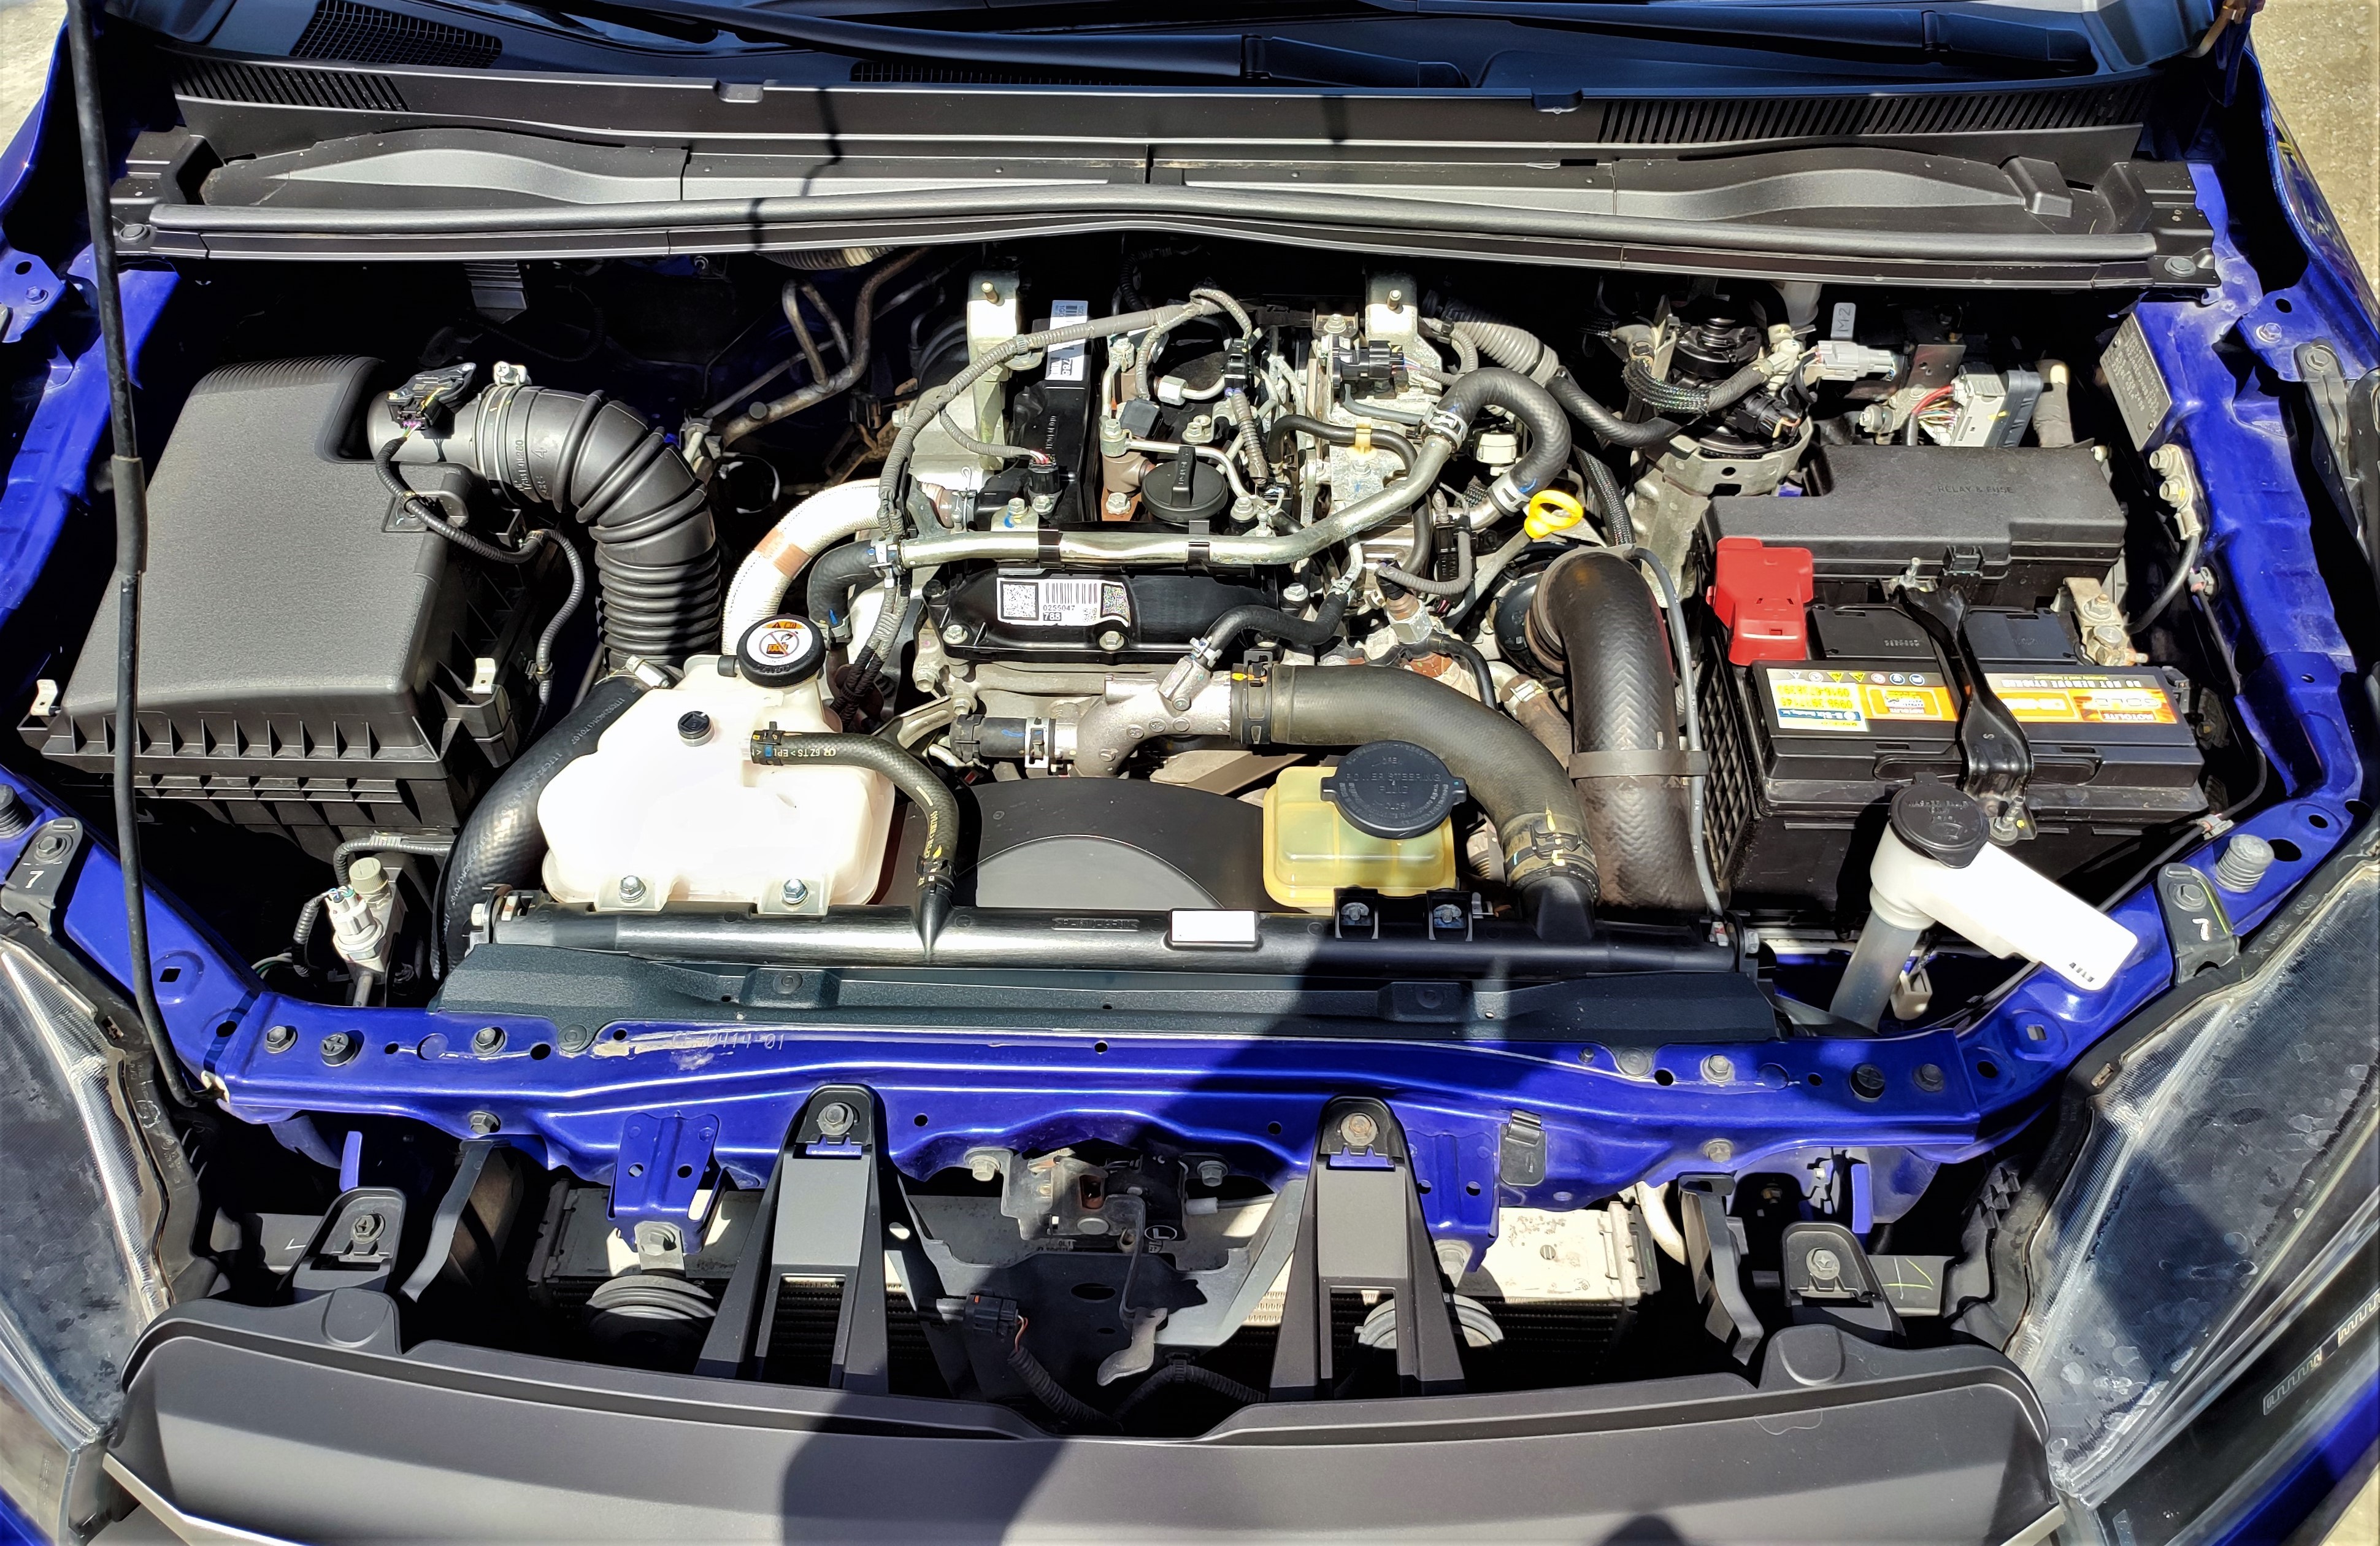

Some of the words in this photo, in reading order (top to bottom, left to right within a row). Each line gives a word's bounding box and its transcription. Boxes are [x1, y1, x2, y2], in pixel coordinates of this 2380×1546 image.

[1836, 307, 1851, 331] M2
[1062, 360, 1072, 375] 788
[1044, 612, 1061, 621] 788
[1388, 773, 1441, 782] STEERING
[25, 871, 45, 889] 7
[1153, 1228, 1170, 1239] L
